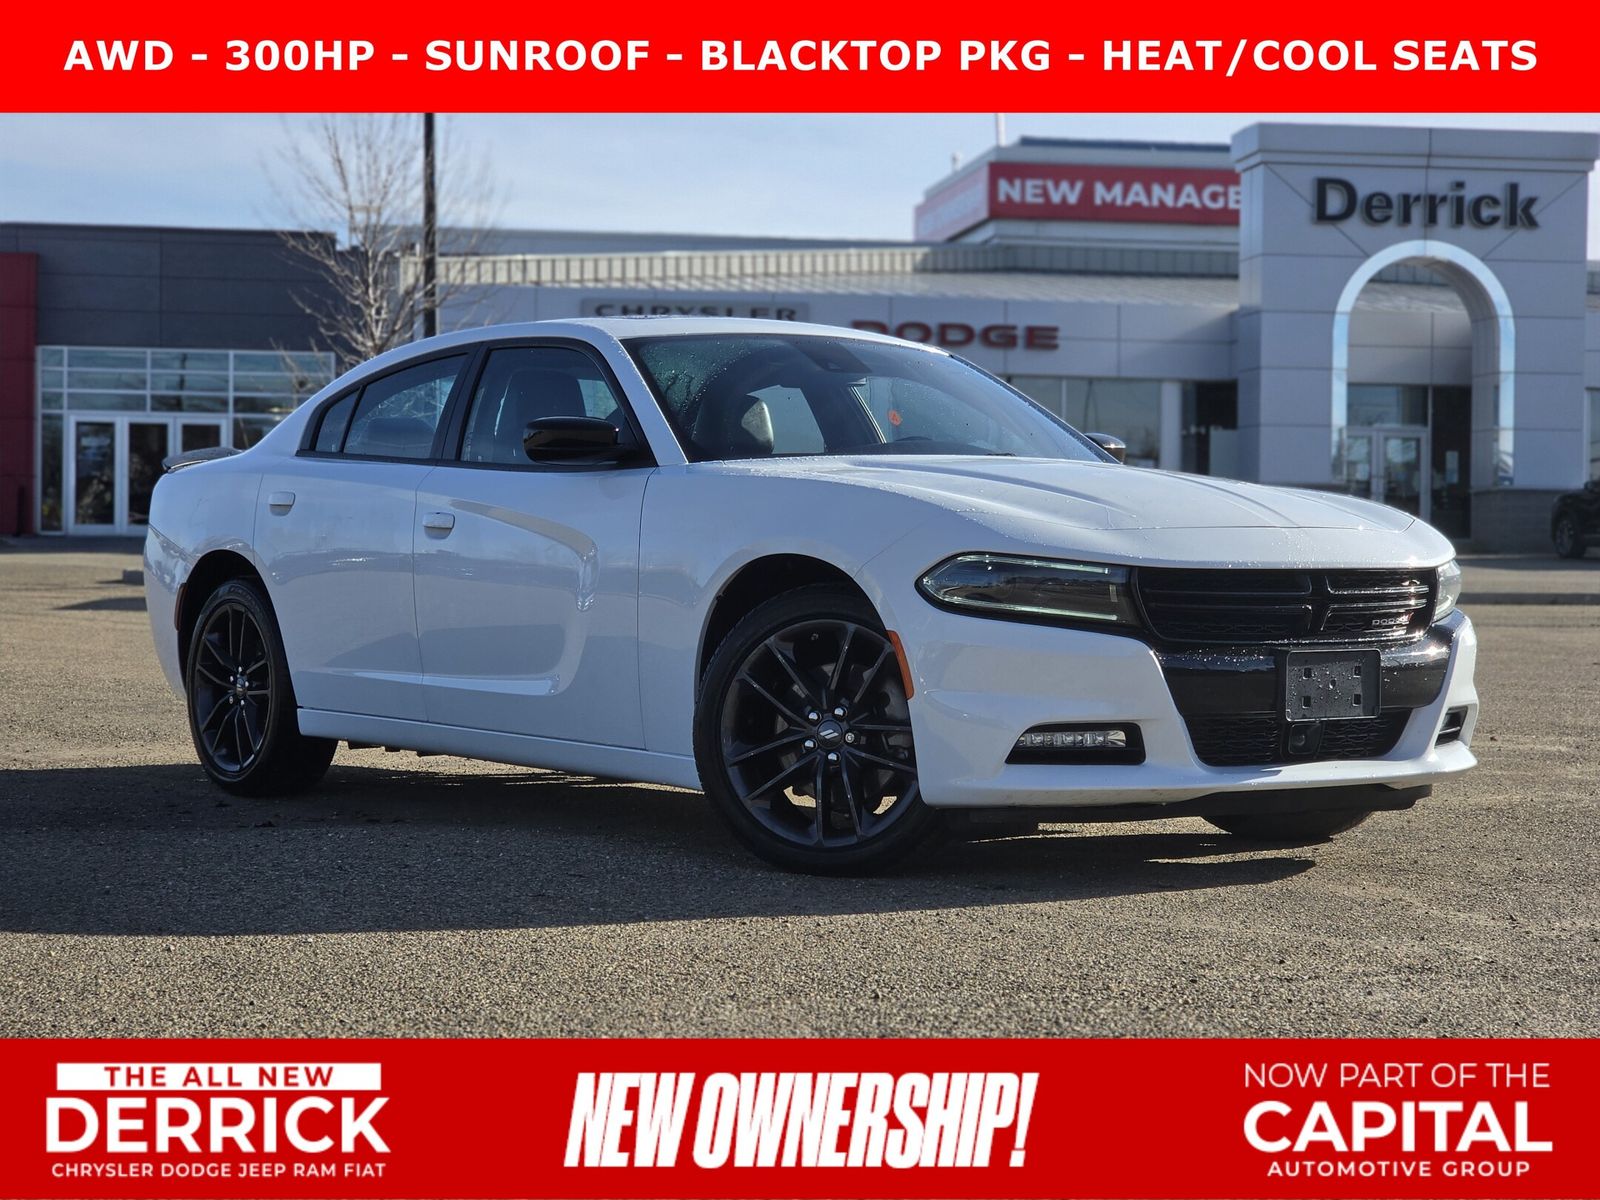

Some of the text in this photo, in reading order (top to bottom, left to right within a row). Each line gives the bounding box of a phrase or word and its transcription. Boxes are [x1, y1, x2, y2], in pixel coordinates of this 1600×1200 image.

[998, 178, 1083, 204] NEW
[1313, 177, 1540, 229] Derrick
[595, 304, 797, 321] CHRYSLER
